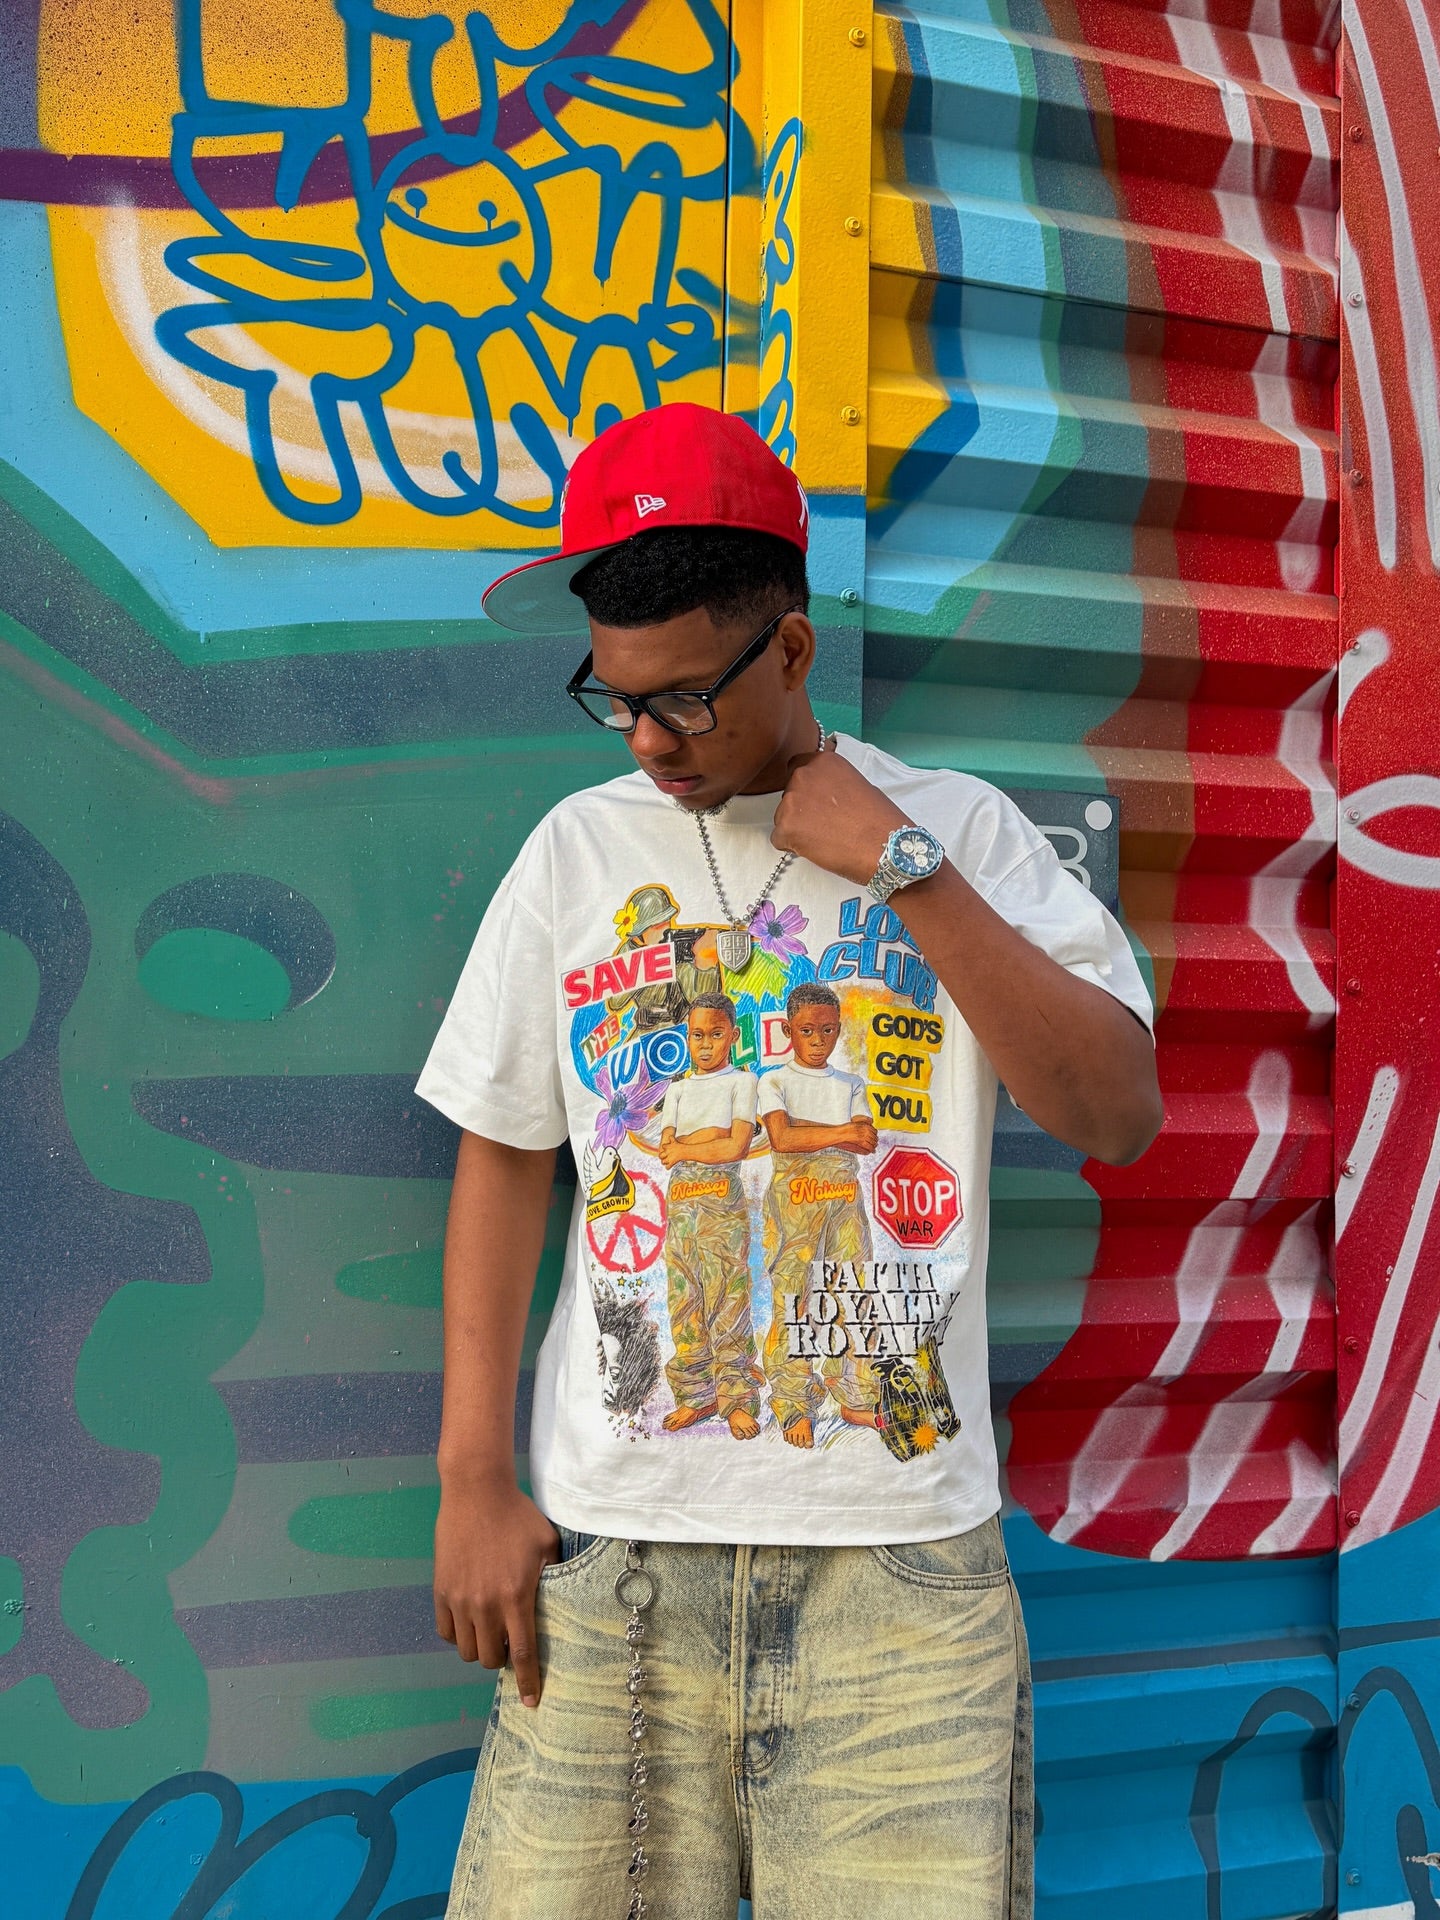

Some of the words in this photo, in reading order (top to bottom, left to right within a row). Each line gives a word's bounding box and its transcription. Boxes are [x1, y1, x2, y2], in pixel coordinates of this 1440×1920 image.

[563, 943, 673, 1008] SAVE
[817, 938, 938, 1014] CLUB
[580, 1015, 620, 1064] THE
[872, 1013, 942, 1044] GOD'S
[608, 1013, 794, 1090] WOLD
[876, 1052, 924, 1080] GOT
[872, 1093, 927, 1123] YOU.
[602, 1197, 629, 1210] GROWTH
[880, 1177, 954, 1217] STOP
[895, 1219, 934, 1238] WAR
[811, 1260, 937, 1293] FAITH
[782, 1291, 961, 1326] LOYALTY
